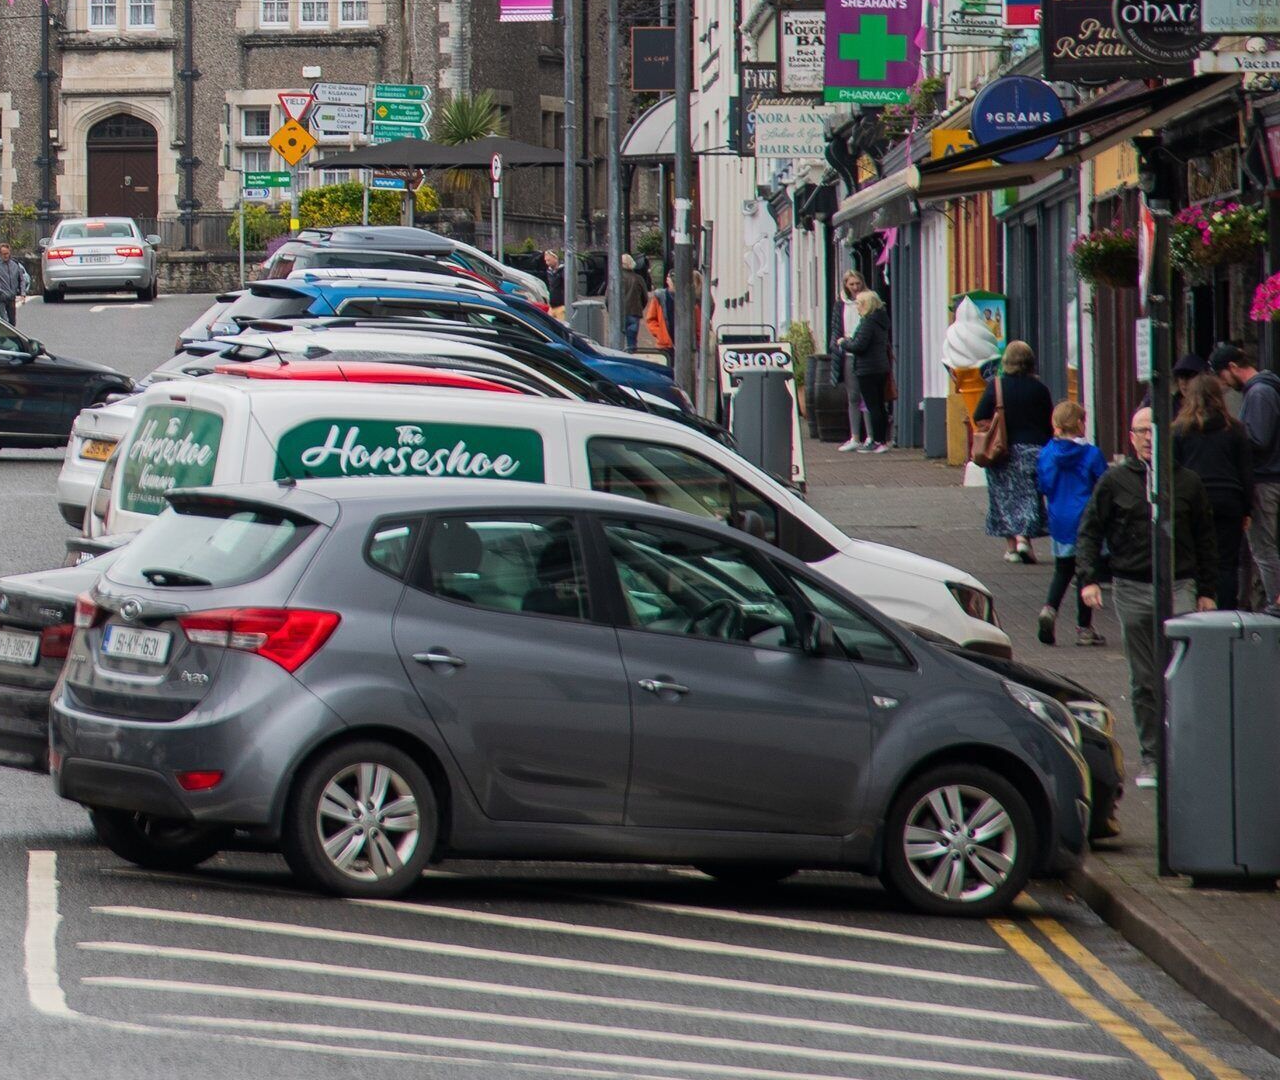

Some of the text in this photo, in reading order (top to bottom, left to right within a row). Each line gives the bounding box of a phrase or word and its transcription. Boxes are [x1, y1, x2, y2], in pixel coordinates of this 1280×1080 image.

[951, 17, 999, 27] National
[796, 36, 826, 47] BA
[1053, 36, 1133, 59] Restau
[796, 49, 817, 57] Bed
[1234, 56, 1280, 70] Vacan
[285, 97, 307, 106] YIELD
[839, 89, 904, 102] PHARMACY
[759, 144, 824, 155] HAIR SALO
[724, 351, 790, 372] SHOP
[396, 424, 427, 446] The
[129, 419, 214, 467] Horseshoe
[301, 424, 521, 478] Horseshoe
